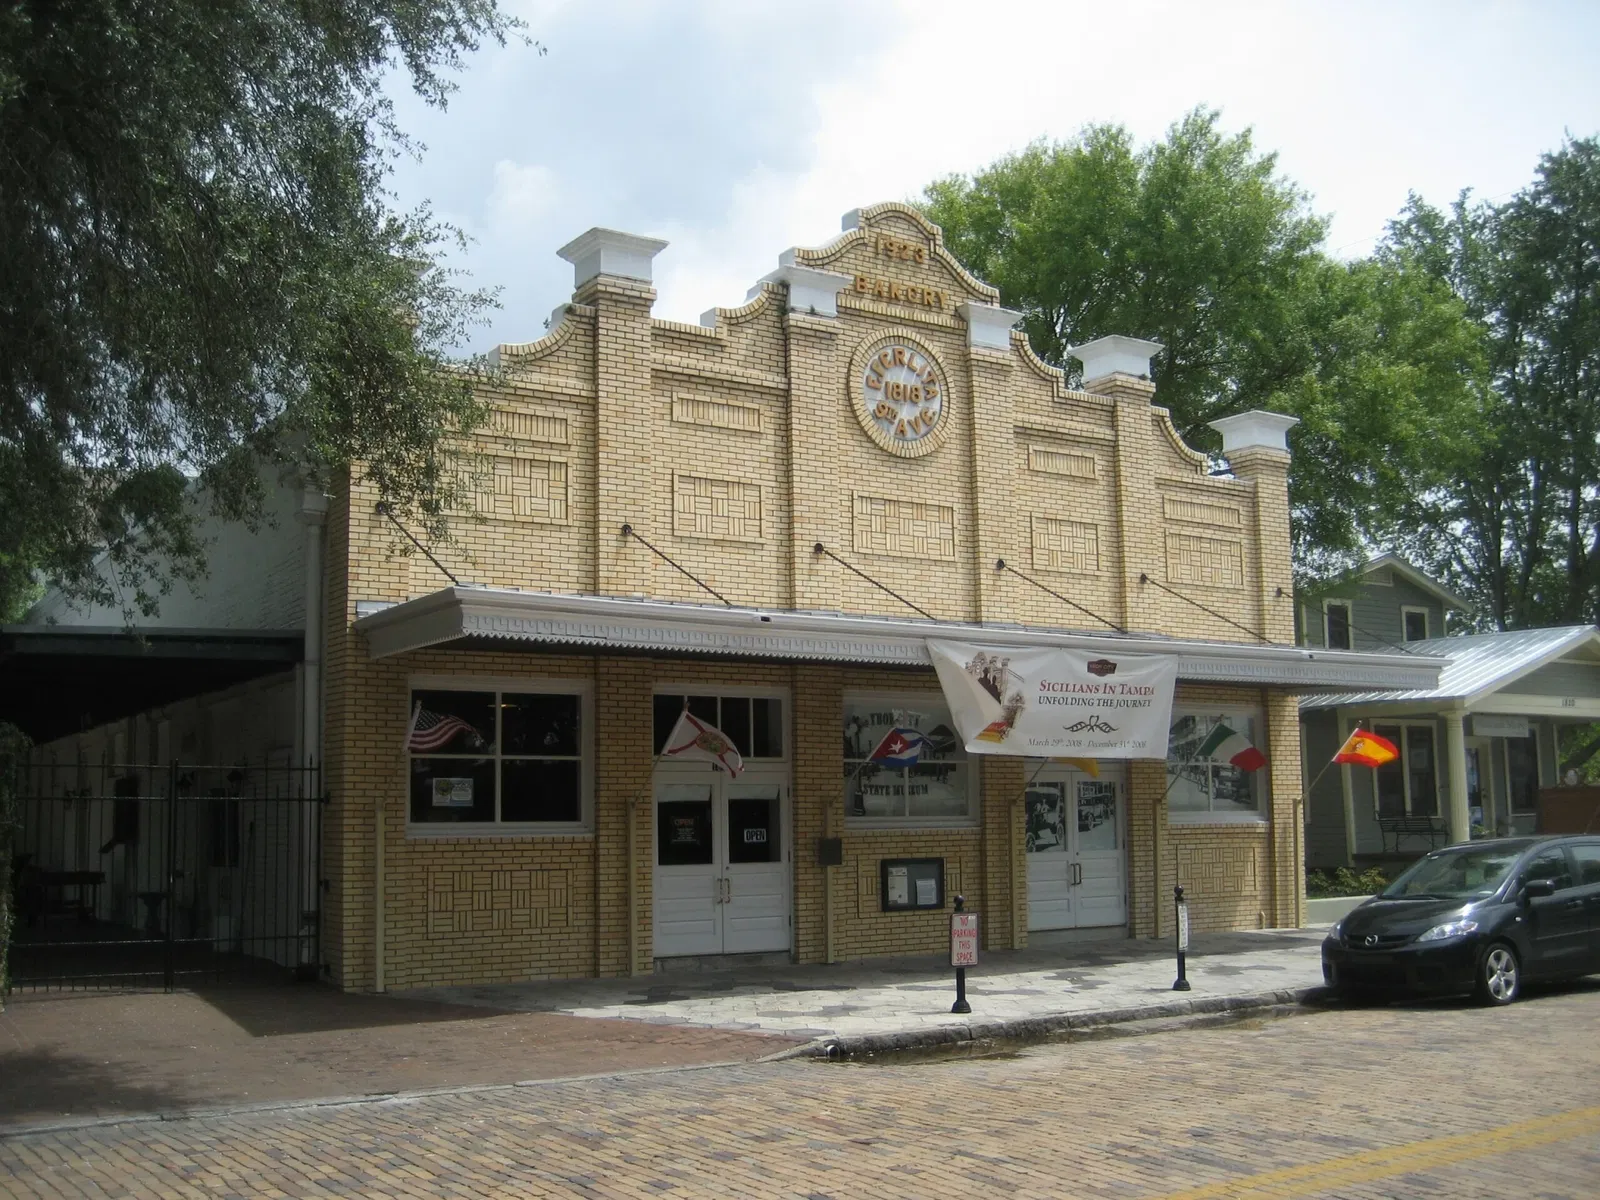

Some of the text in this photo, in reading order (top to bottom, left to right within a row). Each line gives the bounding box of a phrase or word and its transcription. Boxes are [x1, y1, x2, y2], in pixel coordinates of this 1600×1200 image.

[876, 234, 924, 263] 1923
[856, 275, 948, 309] BAKERY
[885, 381, 921, 404] 1818
[1038, 696, 1152, 709] UNFOLDING THE JOURNEY
[1027, 738, 1049, 747] March
[1066, 739, 1082, 747] 2008
[1087, 740, 1118, 748] December
[864, 784, 890, 796] STATE
[745, 830, 765, 841] OPEN
[959, 916, 969, 927] NO
[953, 929, 977, 938] PARKING
[959, 940, 971, 950] THIS
[956, 952, 973, 962] SPACE
